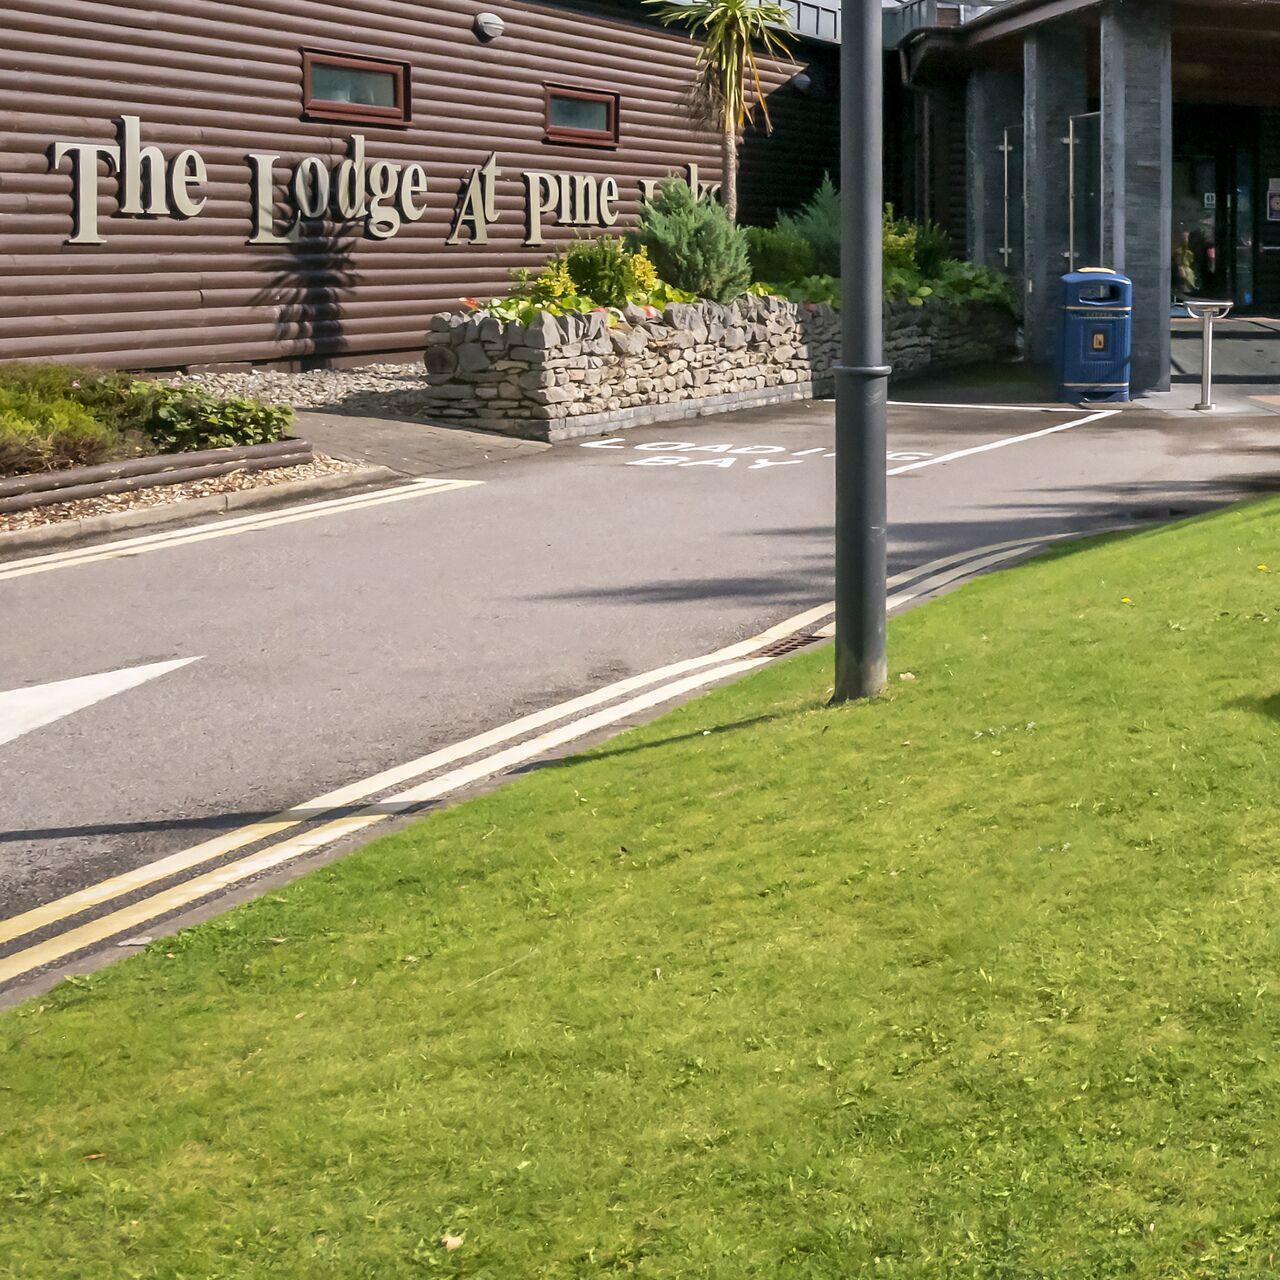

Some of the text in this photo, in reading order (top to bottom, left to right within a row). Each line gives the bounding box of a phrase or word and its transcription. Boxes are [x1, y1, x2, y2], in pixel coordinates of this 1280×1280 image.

[55, 115, 207, 244] The
[247, 134, 428, 244] Lodge
[449, 151, 501, 245] At
[522, 172, 619, 245] Pine
[579, 438, 934, 461] LOADIG
[625, 456, 803, 469] BAY
